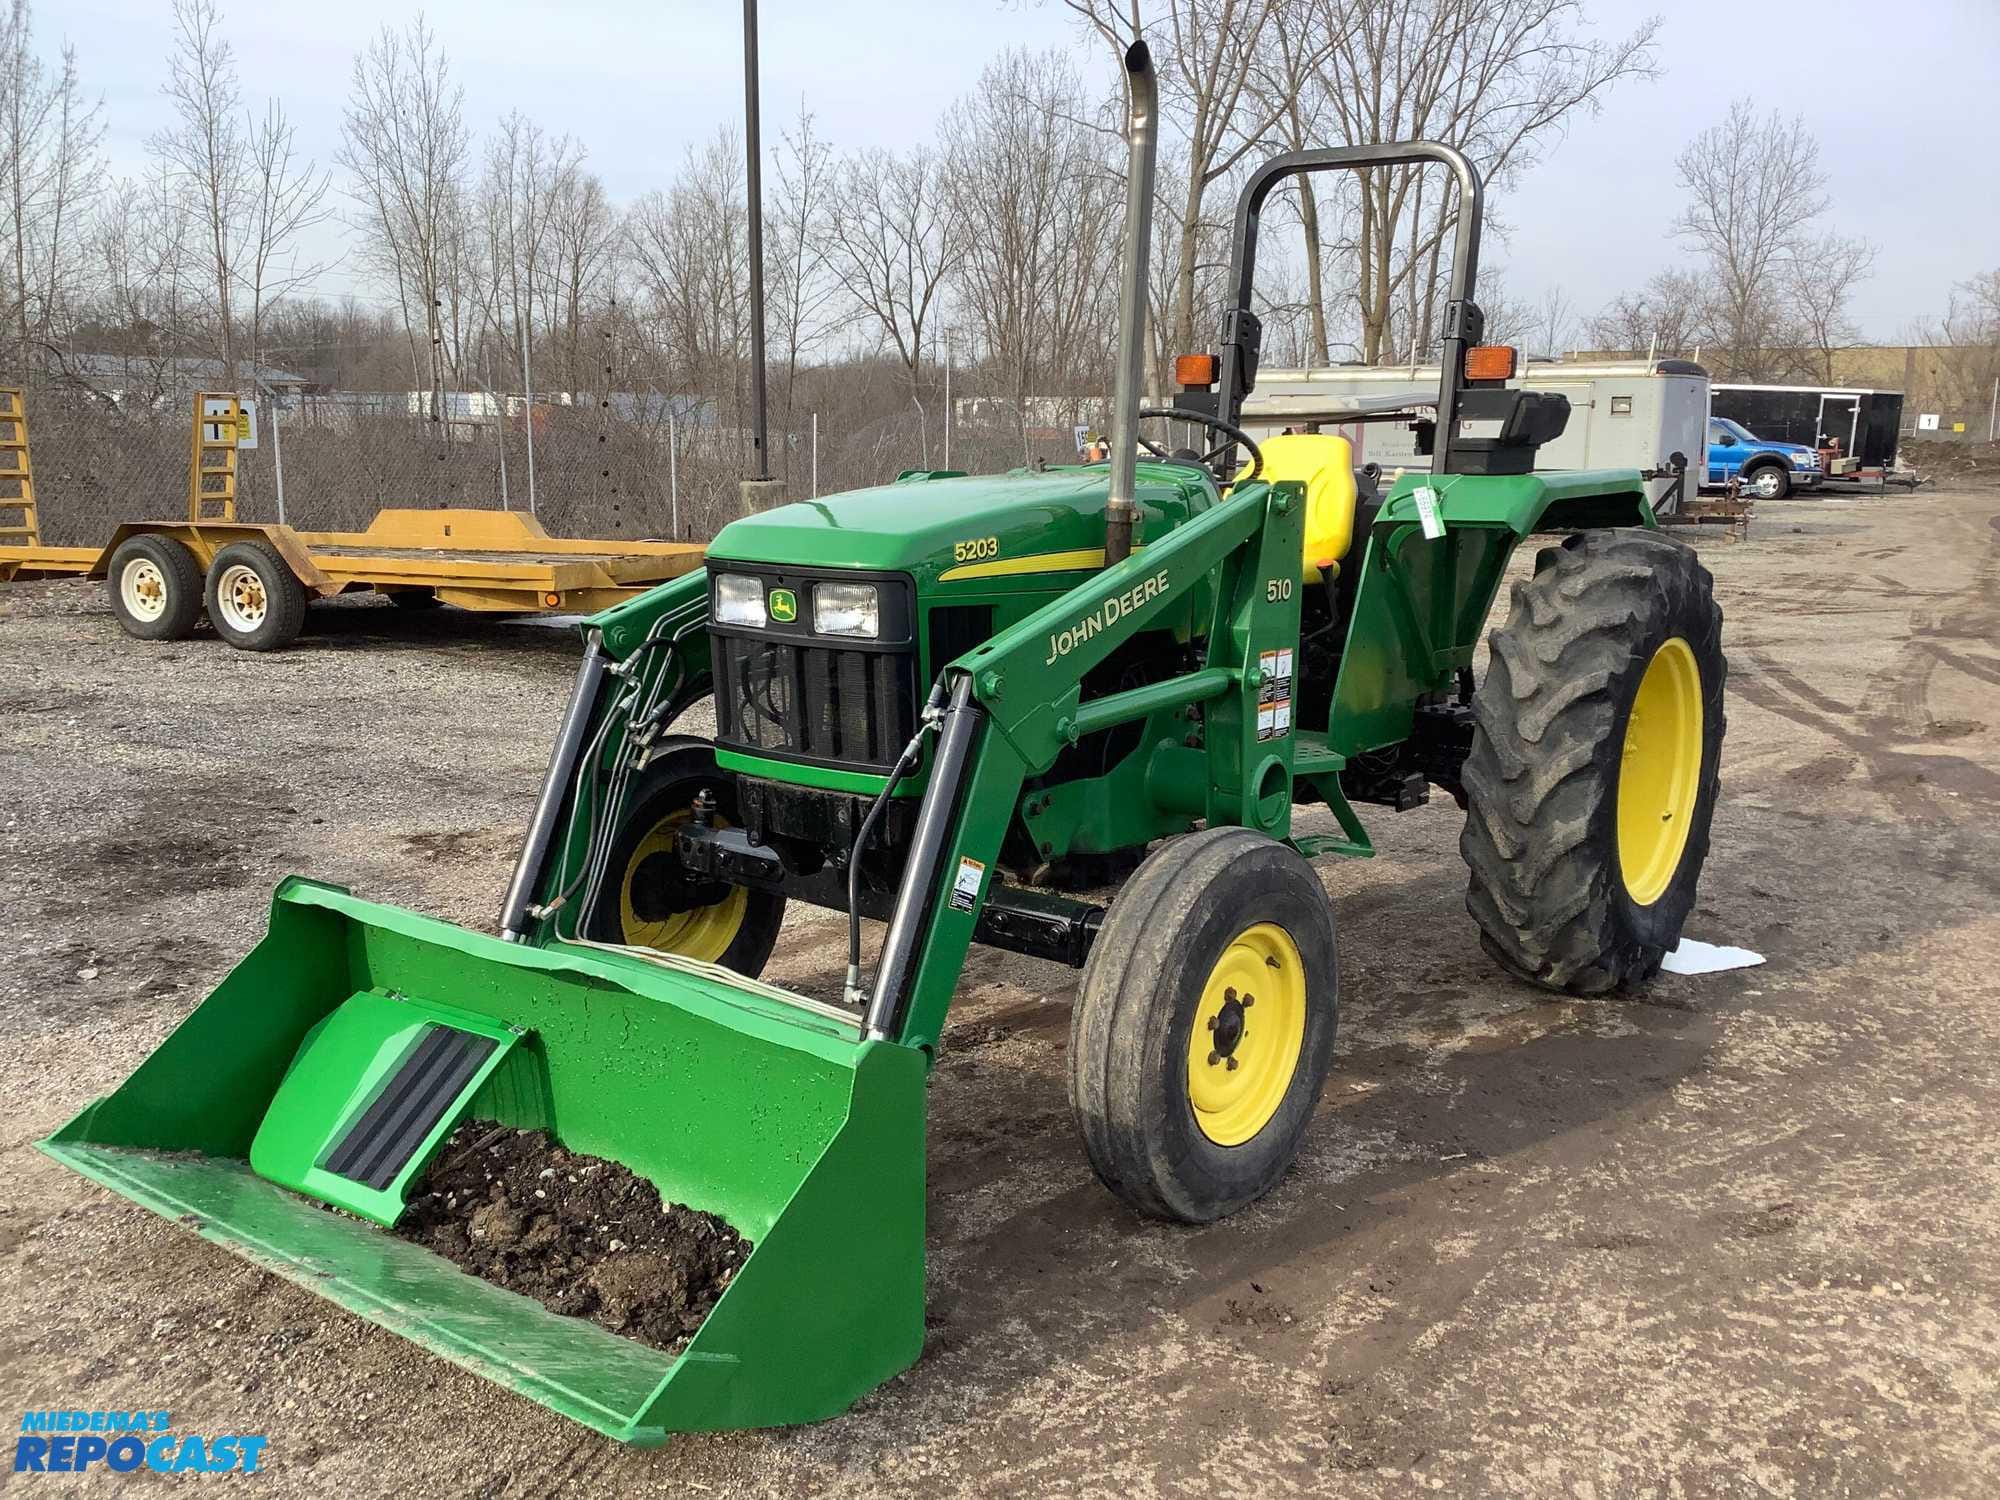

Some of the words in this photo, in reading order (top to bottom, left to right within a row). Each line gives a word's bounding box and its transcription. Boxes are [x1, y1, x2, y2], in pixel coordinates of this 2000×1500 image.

[954, 537, 998, 563] 5203
[1266, 578, 1292, 603] 510
[1046, 610, 1103, 665] JOHN
[1104, 568, 1170, 627] DEERE
